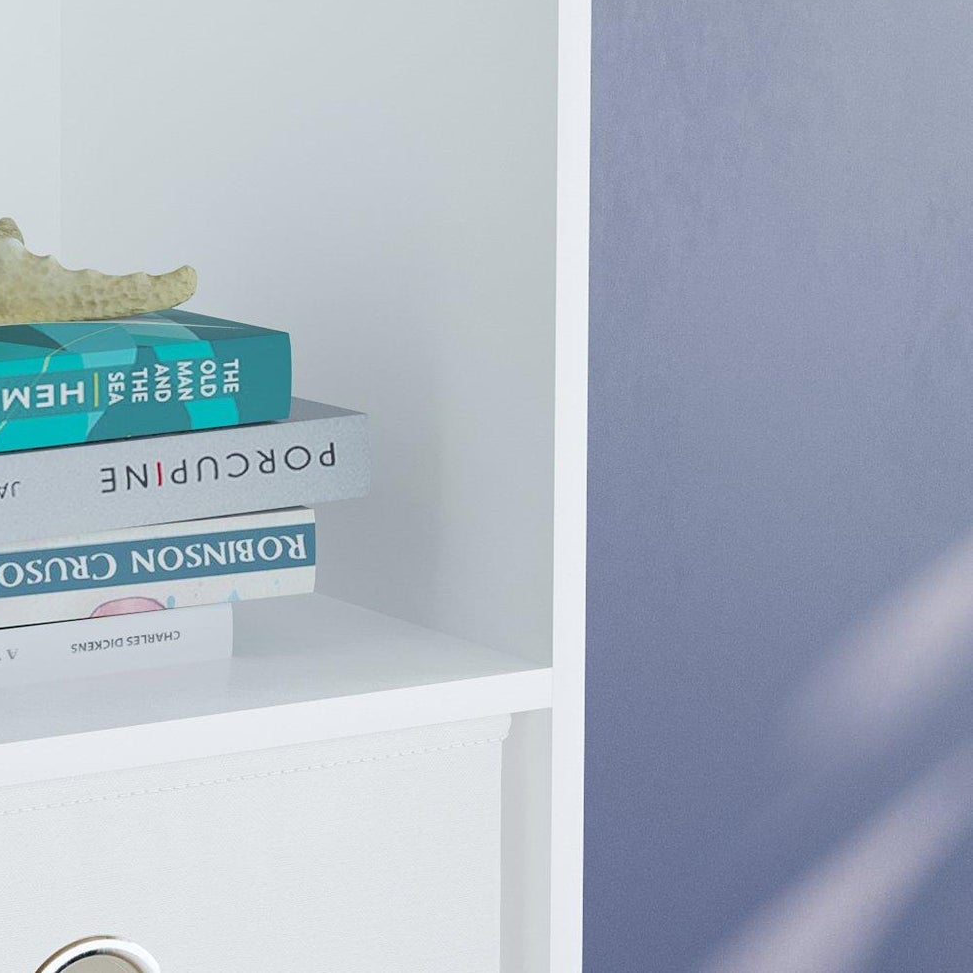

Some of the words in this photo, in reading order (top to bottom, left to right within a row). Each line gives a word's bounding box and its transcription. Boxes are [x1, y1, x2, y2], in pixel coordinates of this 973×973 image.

[108, 371, 125, 406] SEA
[131, 367, 148, 404] THE
[153, 363, 172, 403] AND
[176, 360, 195, 401] MAN
[199, 359, 217, 397] OLD
[223, 358, 240, 393] THE
[100, 442, 336, 494] PORCUPINE
[131, 533, 308, 574] ROBINSON
[6, 648, 20, 661] A
[70, 636, 124, 654] DICKENS
[126, 630, 181, 647] CHARLES
